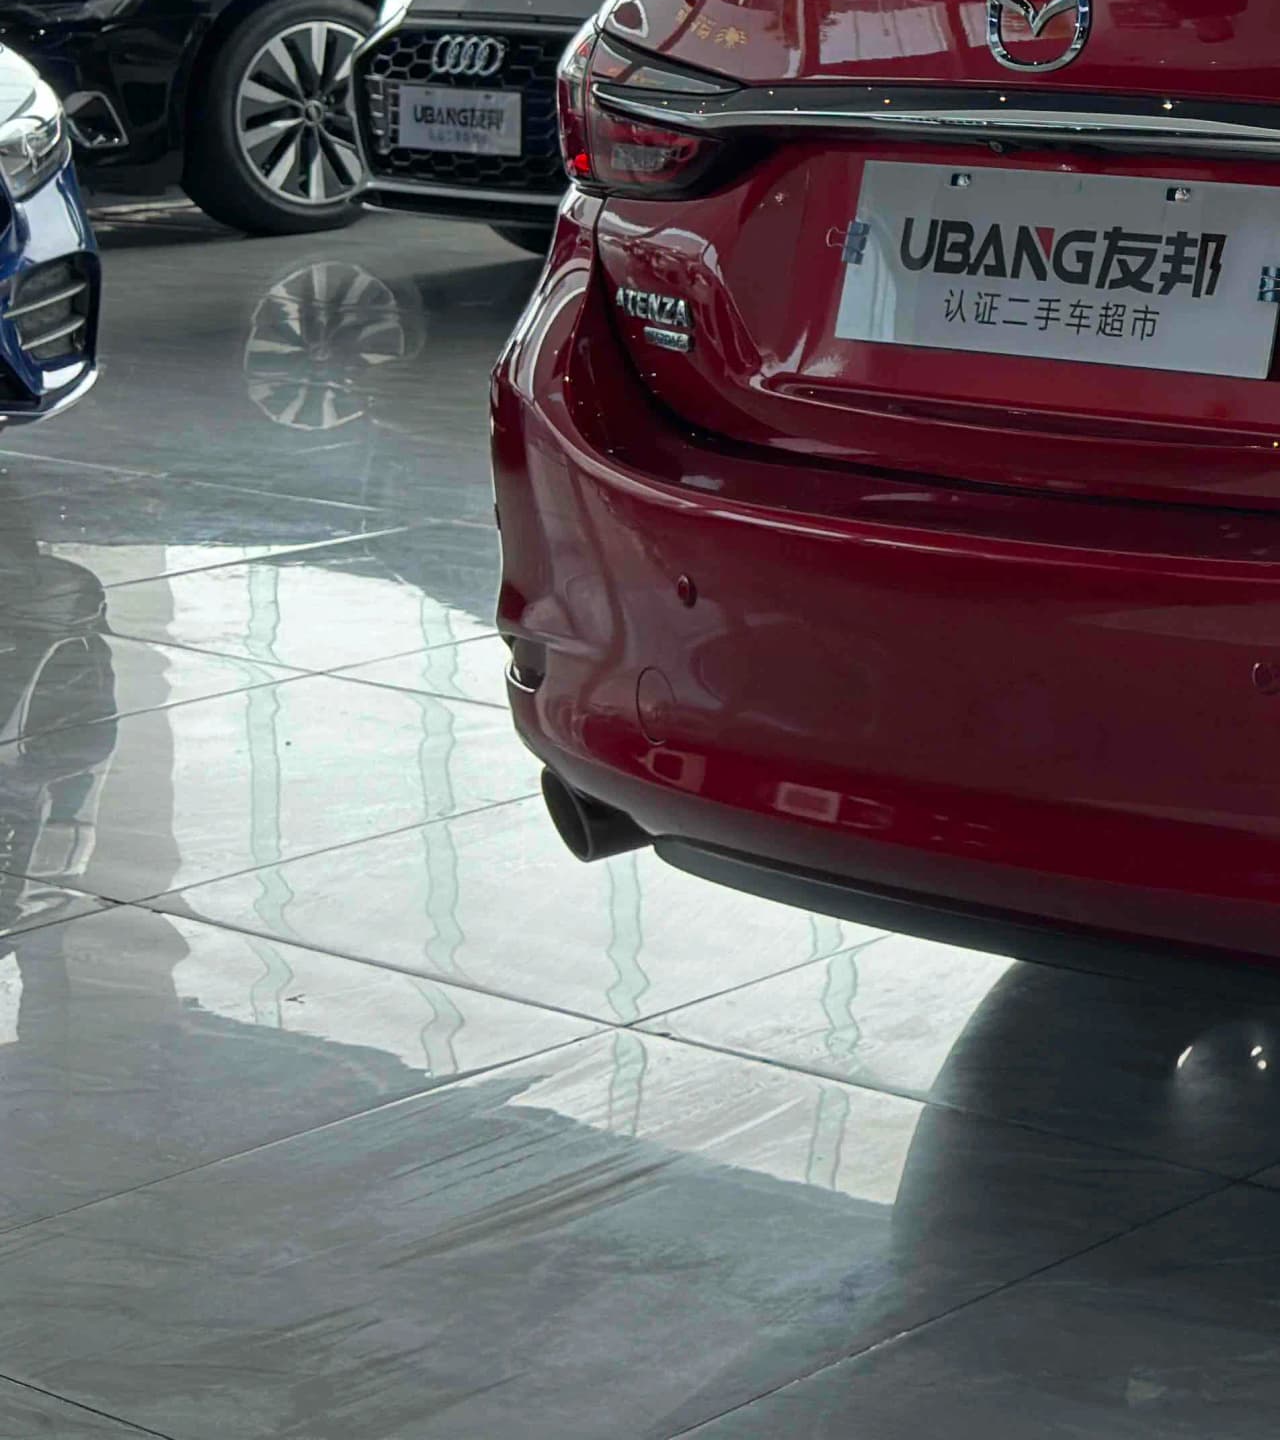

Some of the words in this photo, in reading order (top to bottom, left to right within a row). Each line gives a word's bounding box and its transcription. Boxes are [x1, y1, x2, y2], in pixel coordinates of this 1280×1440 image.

[898, 216, 1229, 299] UBANG友邦
[615, 286, 688, 328] ATENZA
[943, 288, 1161, 341] 认证二手车超市
